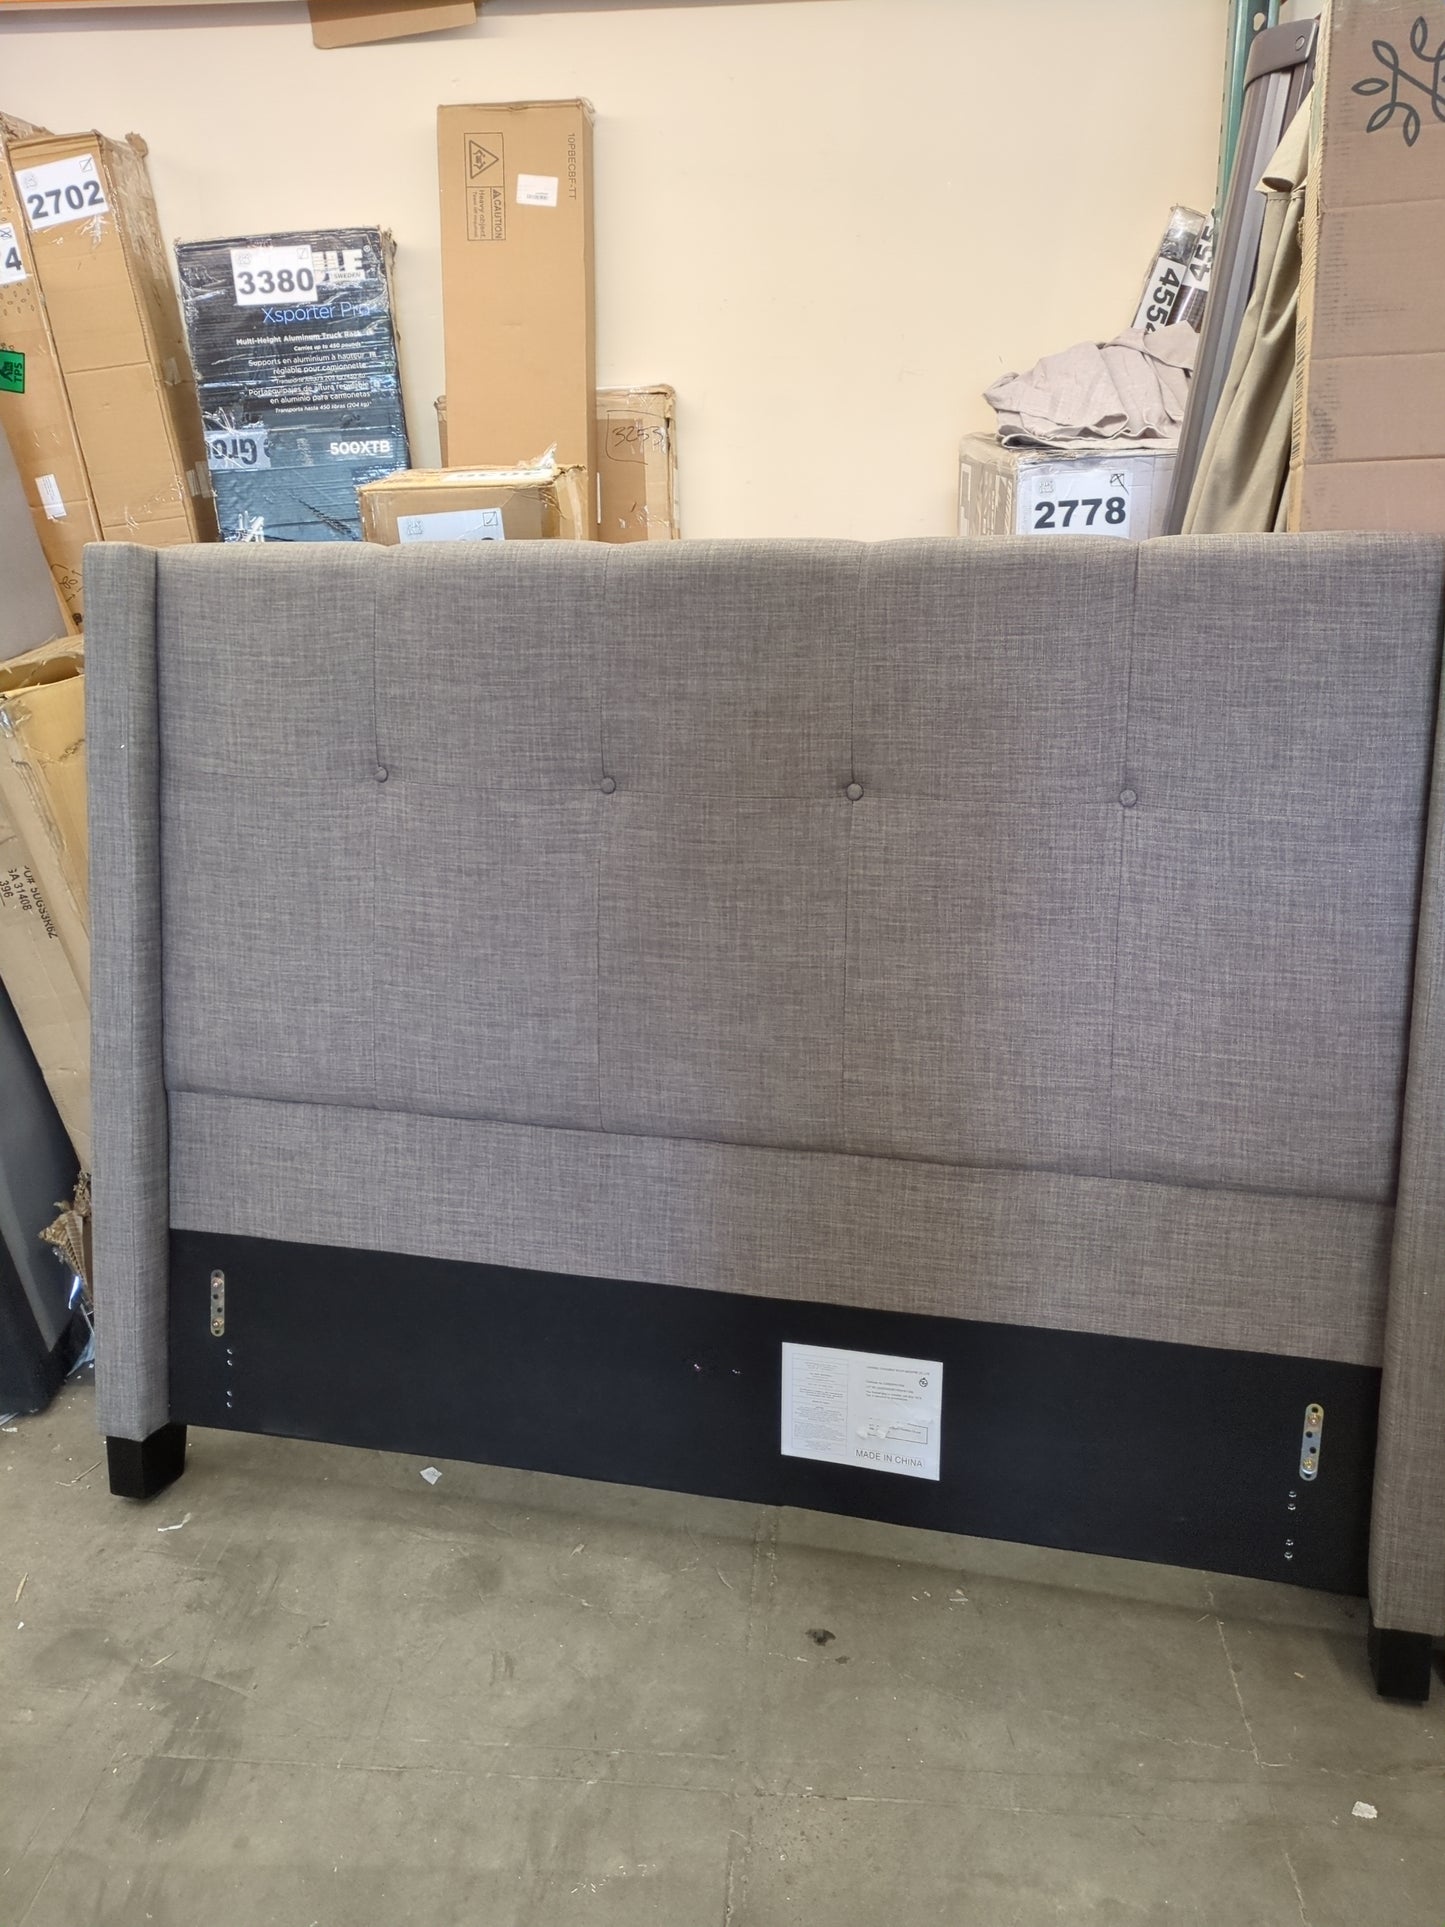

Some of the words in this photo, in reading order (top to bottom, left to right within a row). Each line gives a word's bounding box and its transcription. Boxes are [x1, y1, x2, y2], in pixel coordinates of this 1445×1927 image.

[27, 180, 105, 220] 2702
[493, 199, 503, 239] CAUTION
[236, 267, 315, 295] 3380
[333, 271, 362, 280] SWEDEN
[261, 304, 336, 325] Xsporter
[340, 302, 371, 317] Pro
[236, 336, 282, 346] Multi-Height
[283, 333, 321, 343] Aluminum
[322, 331, 342, 340] Truck
[293, 344, 313, 352] Carries
[248, 358, 281, 367] Supports
[293, 353, 330, 363] aluminium
[331, 352, 337, 360] à
[303, 366, 321, 374] pour
[321, 362, 366, 373] camionnette
[270, 397, 280, 405] en
[280, 394, 311, 404] aluminio
[312, 394, 329, 403] para
[330, 391, 371, 400] camionetas
[330, 440, 391, 455] 500XTB
[1034, 496, 1126, 529] 2778
[14, 882, 32, 911] 31408
[855, 1449, 881, 1461] MADE
[883, 1454, 893, 1463] IN
[894, 1456, 923, 1468] CHINA
